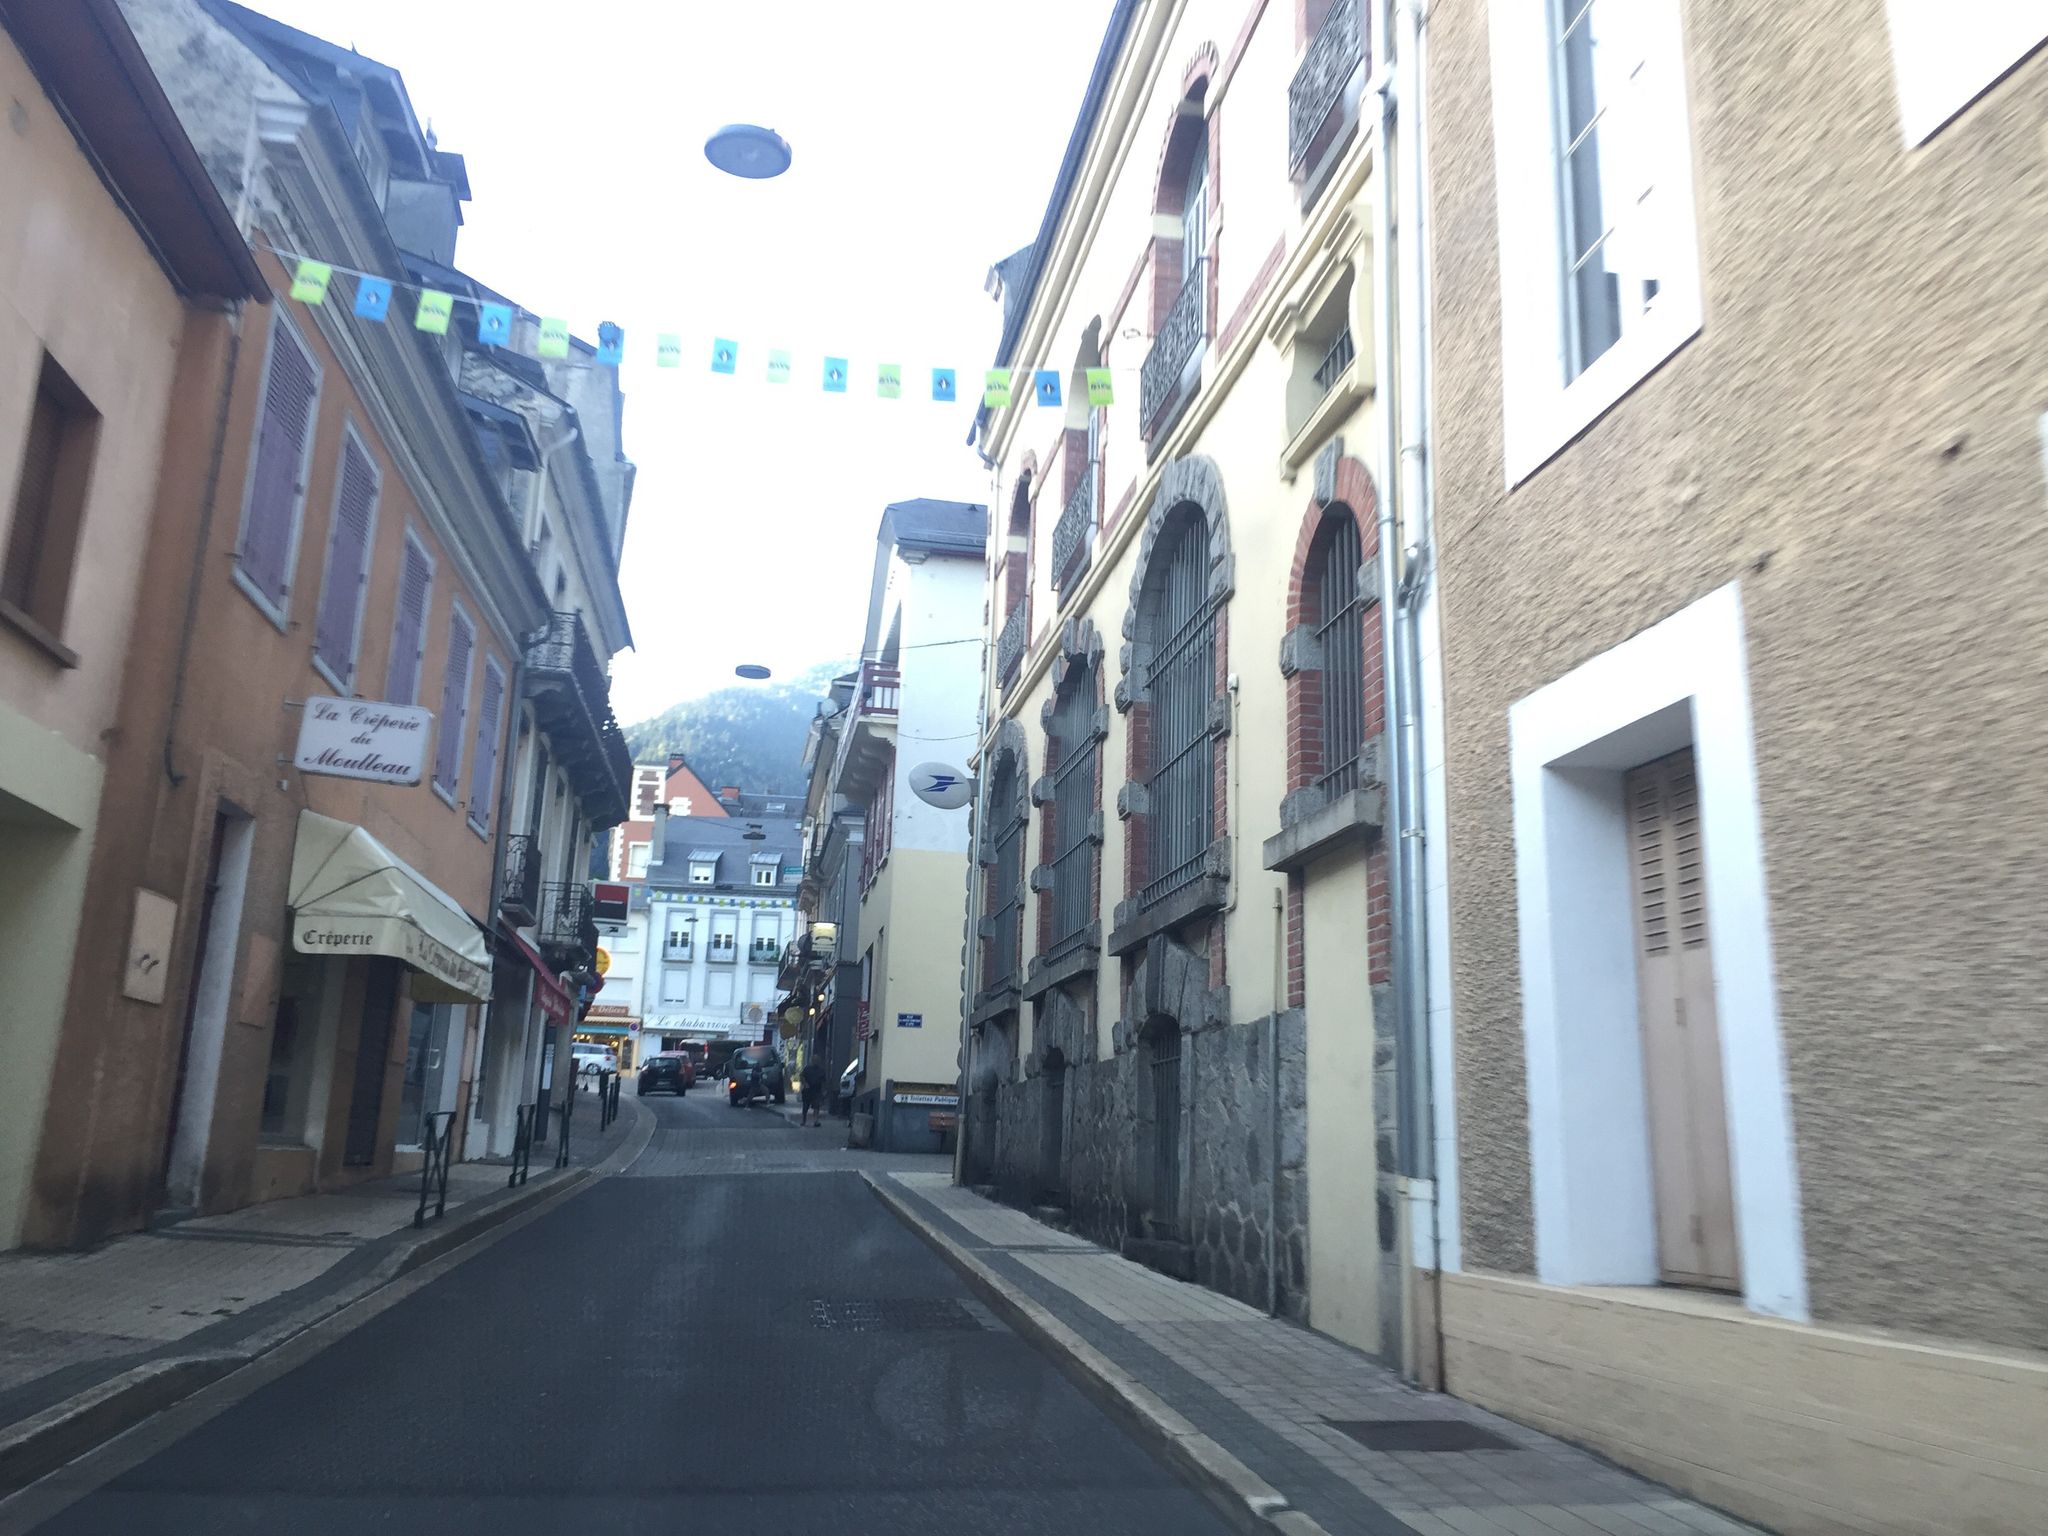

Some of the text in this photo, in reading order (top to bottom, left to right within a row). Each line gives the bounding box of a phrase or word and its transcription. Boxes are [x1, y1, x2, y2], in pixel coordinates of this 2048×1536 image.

[314, 702, 420, 733] La Crêperie
[350, 732, 372, 745] du
[302, 929, 374, 947] Crêperie
